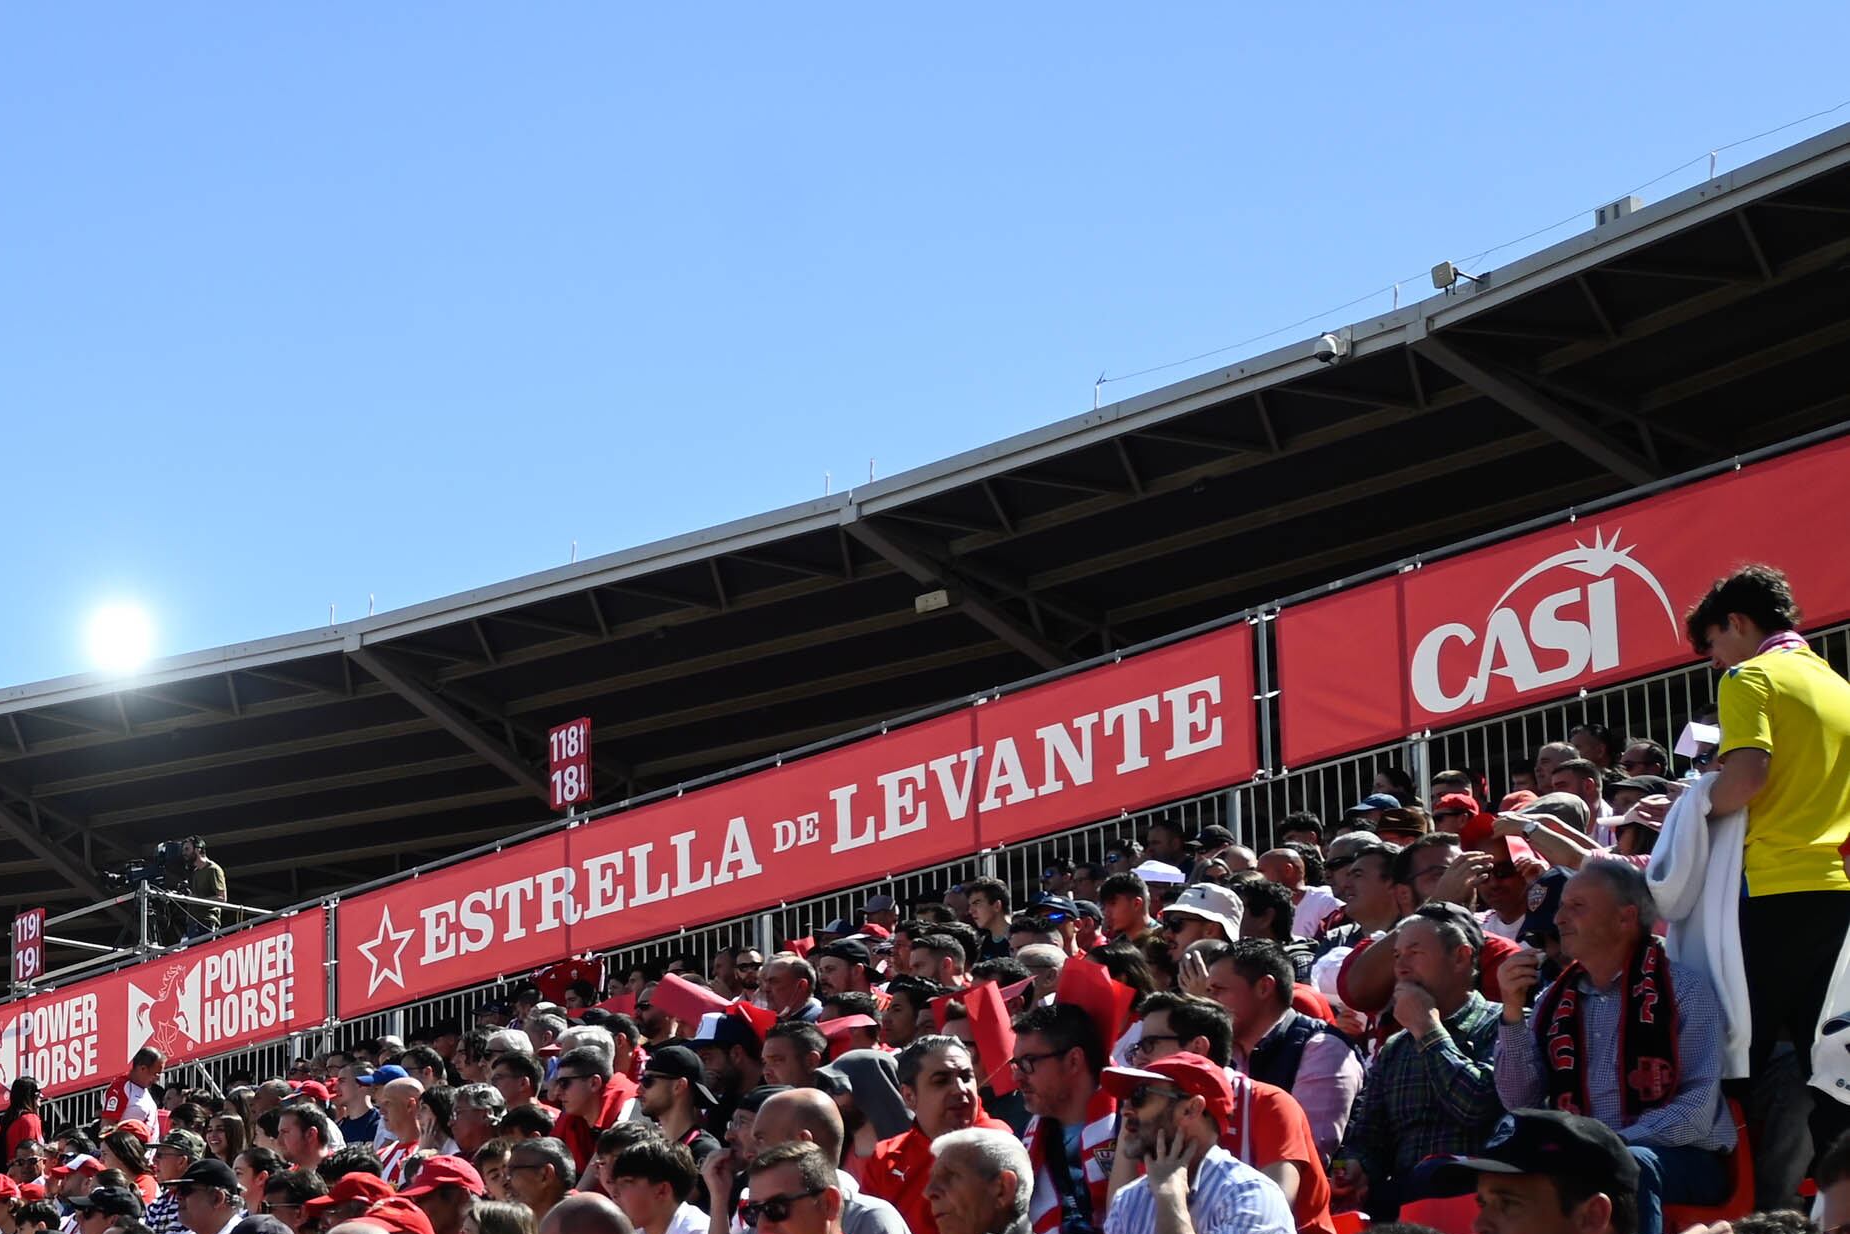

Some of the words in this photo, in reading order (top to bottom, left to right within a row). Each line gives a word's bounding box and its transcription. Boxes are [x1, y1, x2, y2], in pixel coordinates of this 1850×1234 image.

[1411, 577, 1620, 714] CASI
[550, 726, 579, 762] 118
[552, 766, 579, 804] 18
[419, 815, 763, 966] ESTRELLA
[773, 812, 820, 855] DE
[830, 676, 1223, 855] LEVANTE
[16, 913, 36, 943] 119
[16, 947, 35, 979] 19
[205, 932, 294, 993] POWER
[20, 993, 98, 1044] POWER
[205, 978, 295, 1043] HORSE
[20, 1034, 98, 1088] HORSE
